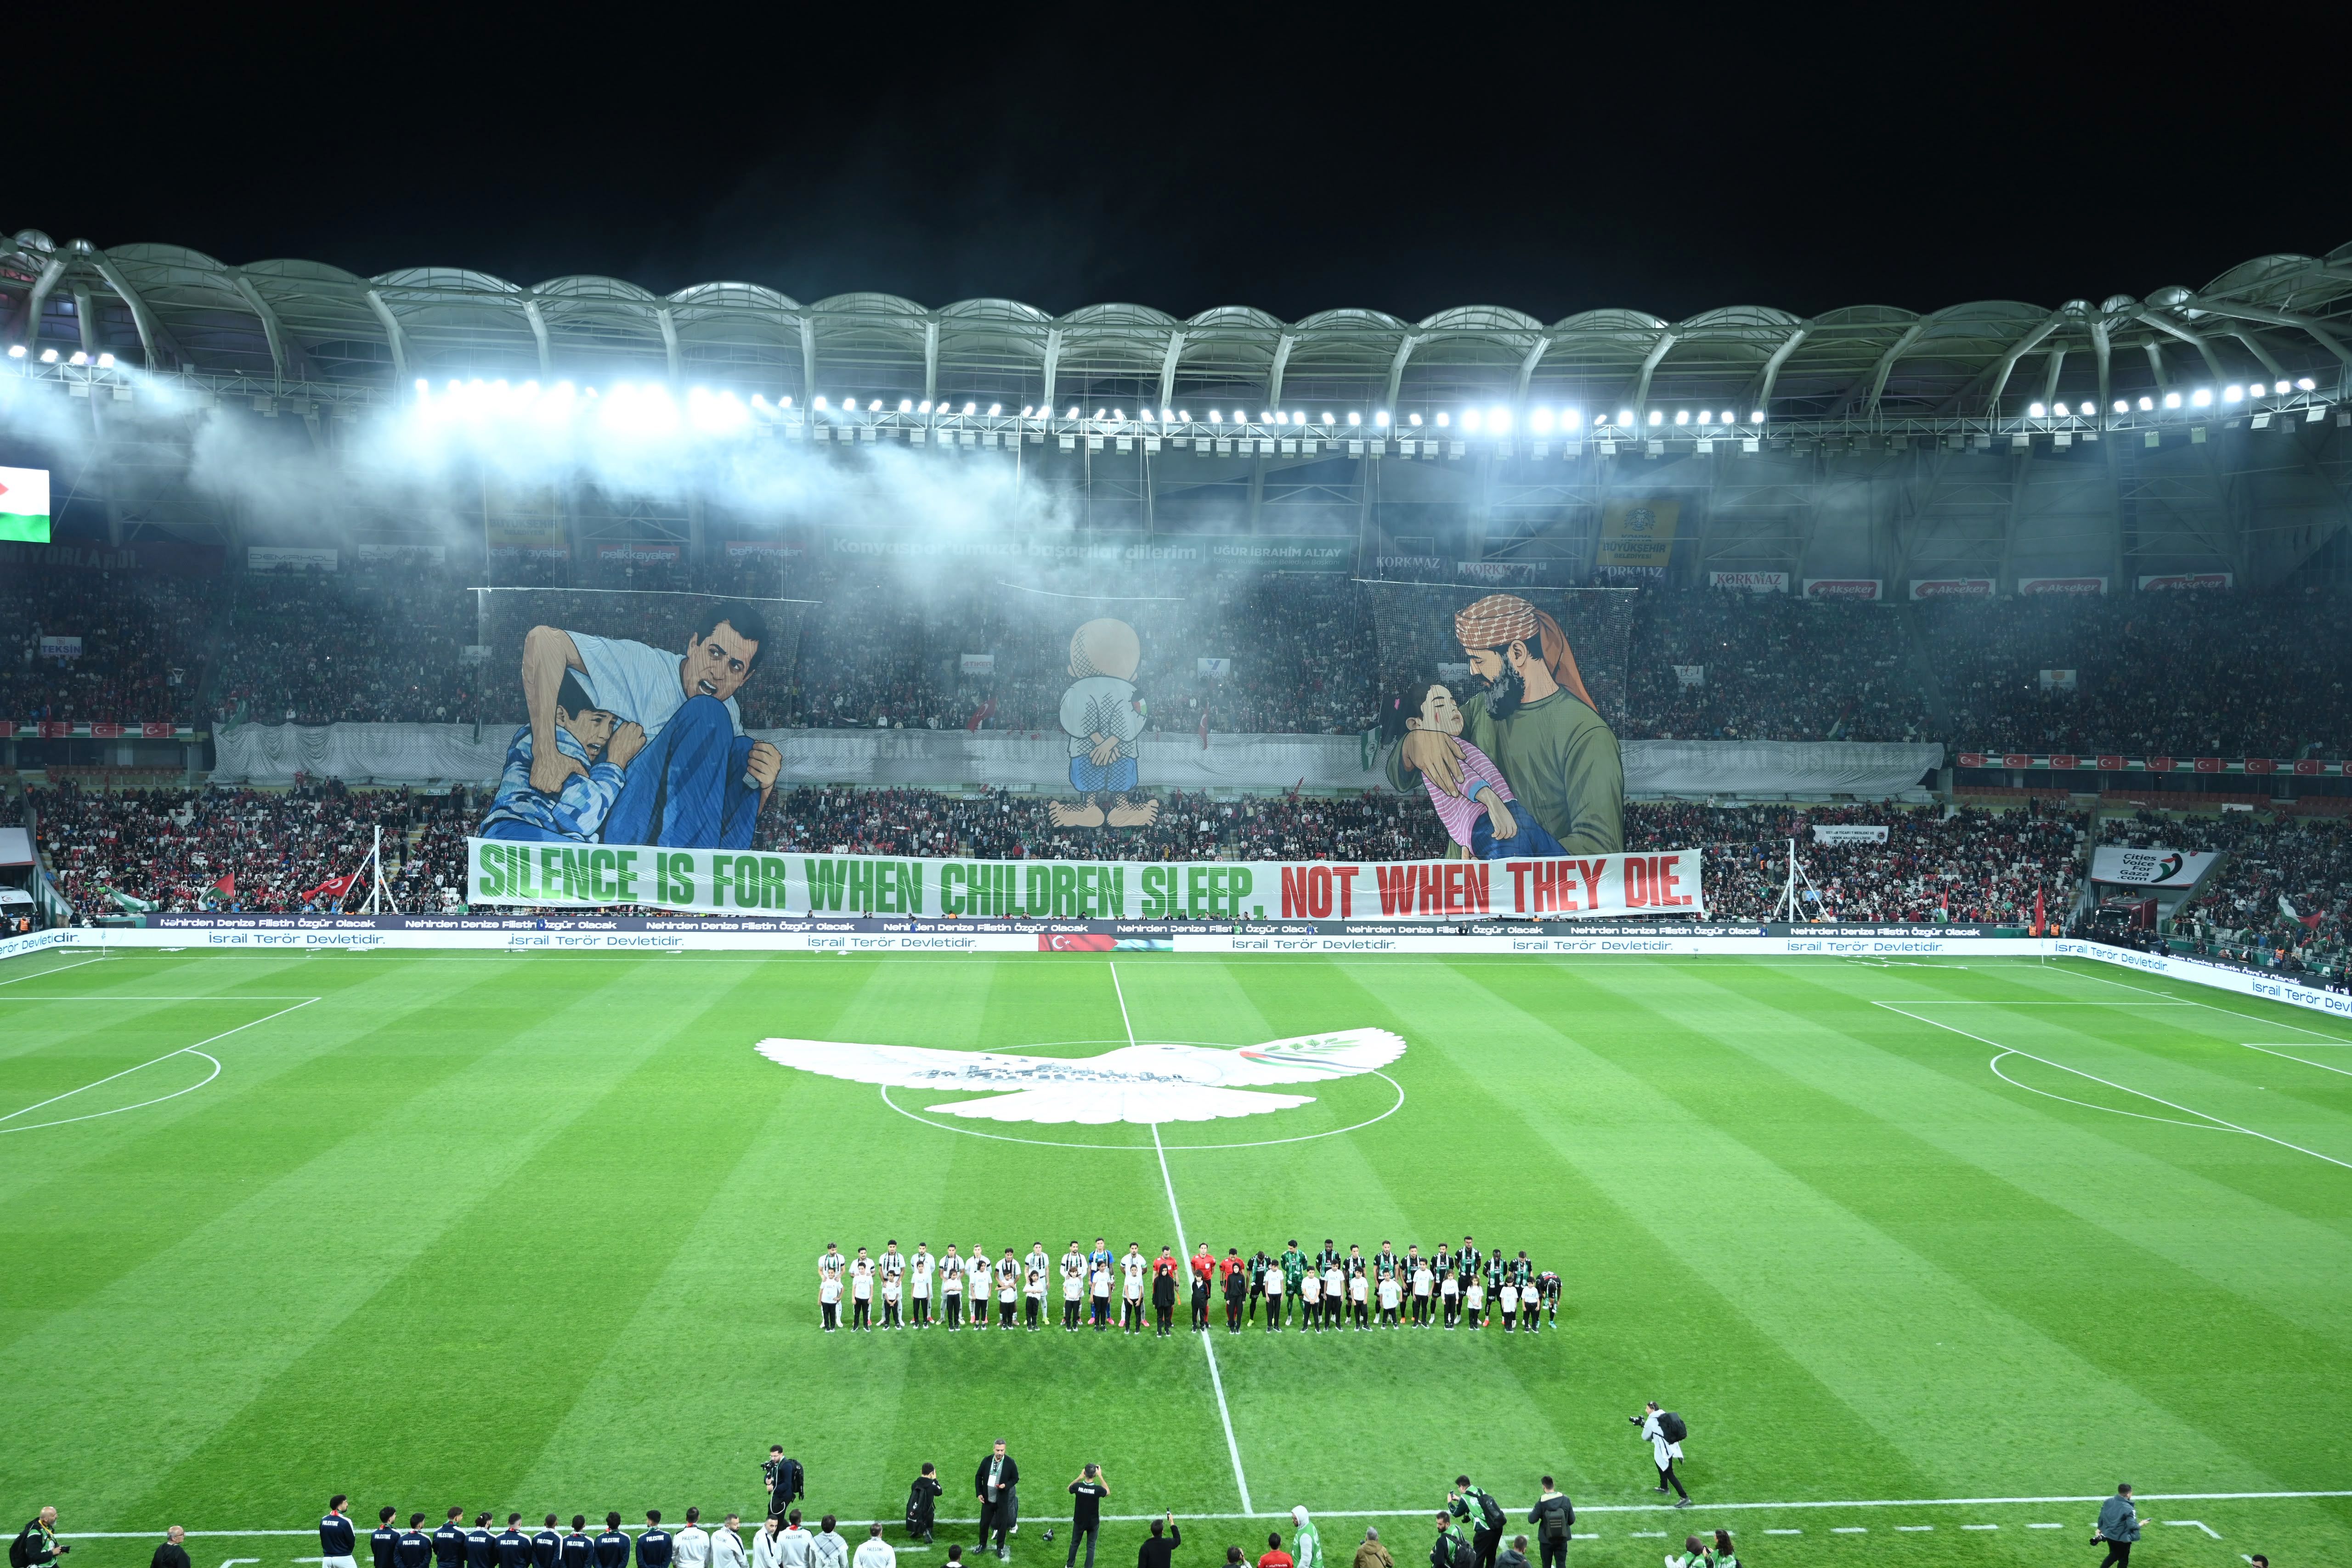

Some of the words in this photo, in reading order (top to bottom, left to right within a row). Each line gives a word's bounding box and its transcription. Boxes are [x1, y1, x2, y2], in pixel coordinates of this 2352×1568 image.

[1125, 544, 1197, 559] dilerim
[1213, 546, 1248, 557] UĞUR
[1250, 546, 1300, 557] İBRAHİM
[1304, 548, 1342, 558] ALTAY
[1603, 541, 1666, 553] BÜYÜKŞEHİR
[1238, 557, 1277, 565] Büyükşehir
[1376, 557, 1440, 568] KORKMAZ
[1465, 564, 1529, 575] KORKMAZ
[1717, 574, 1782, 585] KORKMAZ
[41, 644, 81, 654] TEKSİN
[480, 844, 638, 902] SILENCE
[657, 852, 695, 905] IS
[713, 855, 786, 909] FOR
[804, 859, 923, 914] WHEN
[941, 863, 1124, 918] CHILDREN
[1282, 866, 1359, 918] NOT
[1376, 863, 1489, 916] WHEN
[1506, 859, 1606, 913] THEY
[1624, 856, 1692, 908] DIE.
[298, 918, 333, 928] Özgür
[779, 921, 814, 931] Özgür
[1014, 923, 1048, 932] Özgür
[1246, 924, 1278, 934] Özgür
[1472, 925, 1504, 935] Özgür
[1694, 925, 1726, 936] Özgür
[1911, 927, 1943, 937] Özgür
[23, 933, 79, 949] Devletidir.
[209, 932, 247, 943] İsrail
[254, 933, 300, 943] Terör
[307, 934, 385, 944] Devletidir.
[511, 934, 548, 945] İsrail
[556, 936, 600, 945] Terör
[608, 936, 684, 945] Devletidir.
[808, 936, 844, 946] İsrail
[851, 937, 895, 947] Terör
[902, 938, 977, 947] Devletidir.
[1233, 937, 1268, 948] İsrail
[1274, 939, 1317, 948] Terör
[1323, 940, 1396, 949] Devletidir.
[1513, 939, 1547, 949] İsrail
[1554, 940, 1596, 950] Terör
[1602, 941, 1673, 950] Devletidir.
[1787, 940, 1821, 951] İsrail
[1827, 942, 1868, 951] Terör
[1875, 942, 1943, 951] Devletidir.
[2055, 941, 2087, 954] İsrail
[2091, 947, 2118, 959] Terör
[2122, 953, 2168, 971] Devletidir.
[2253, 979, 2280, 996] İsrail
[2285, 989, 2320, 1005] Terör
